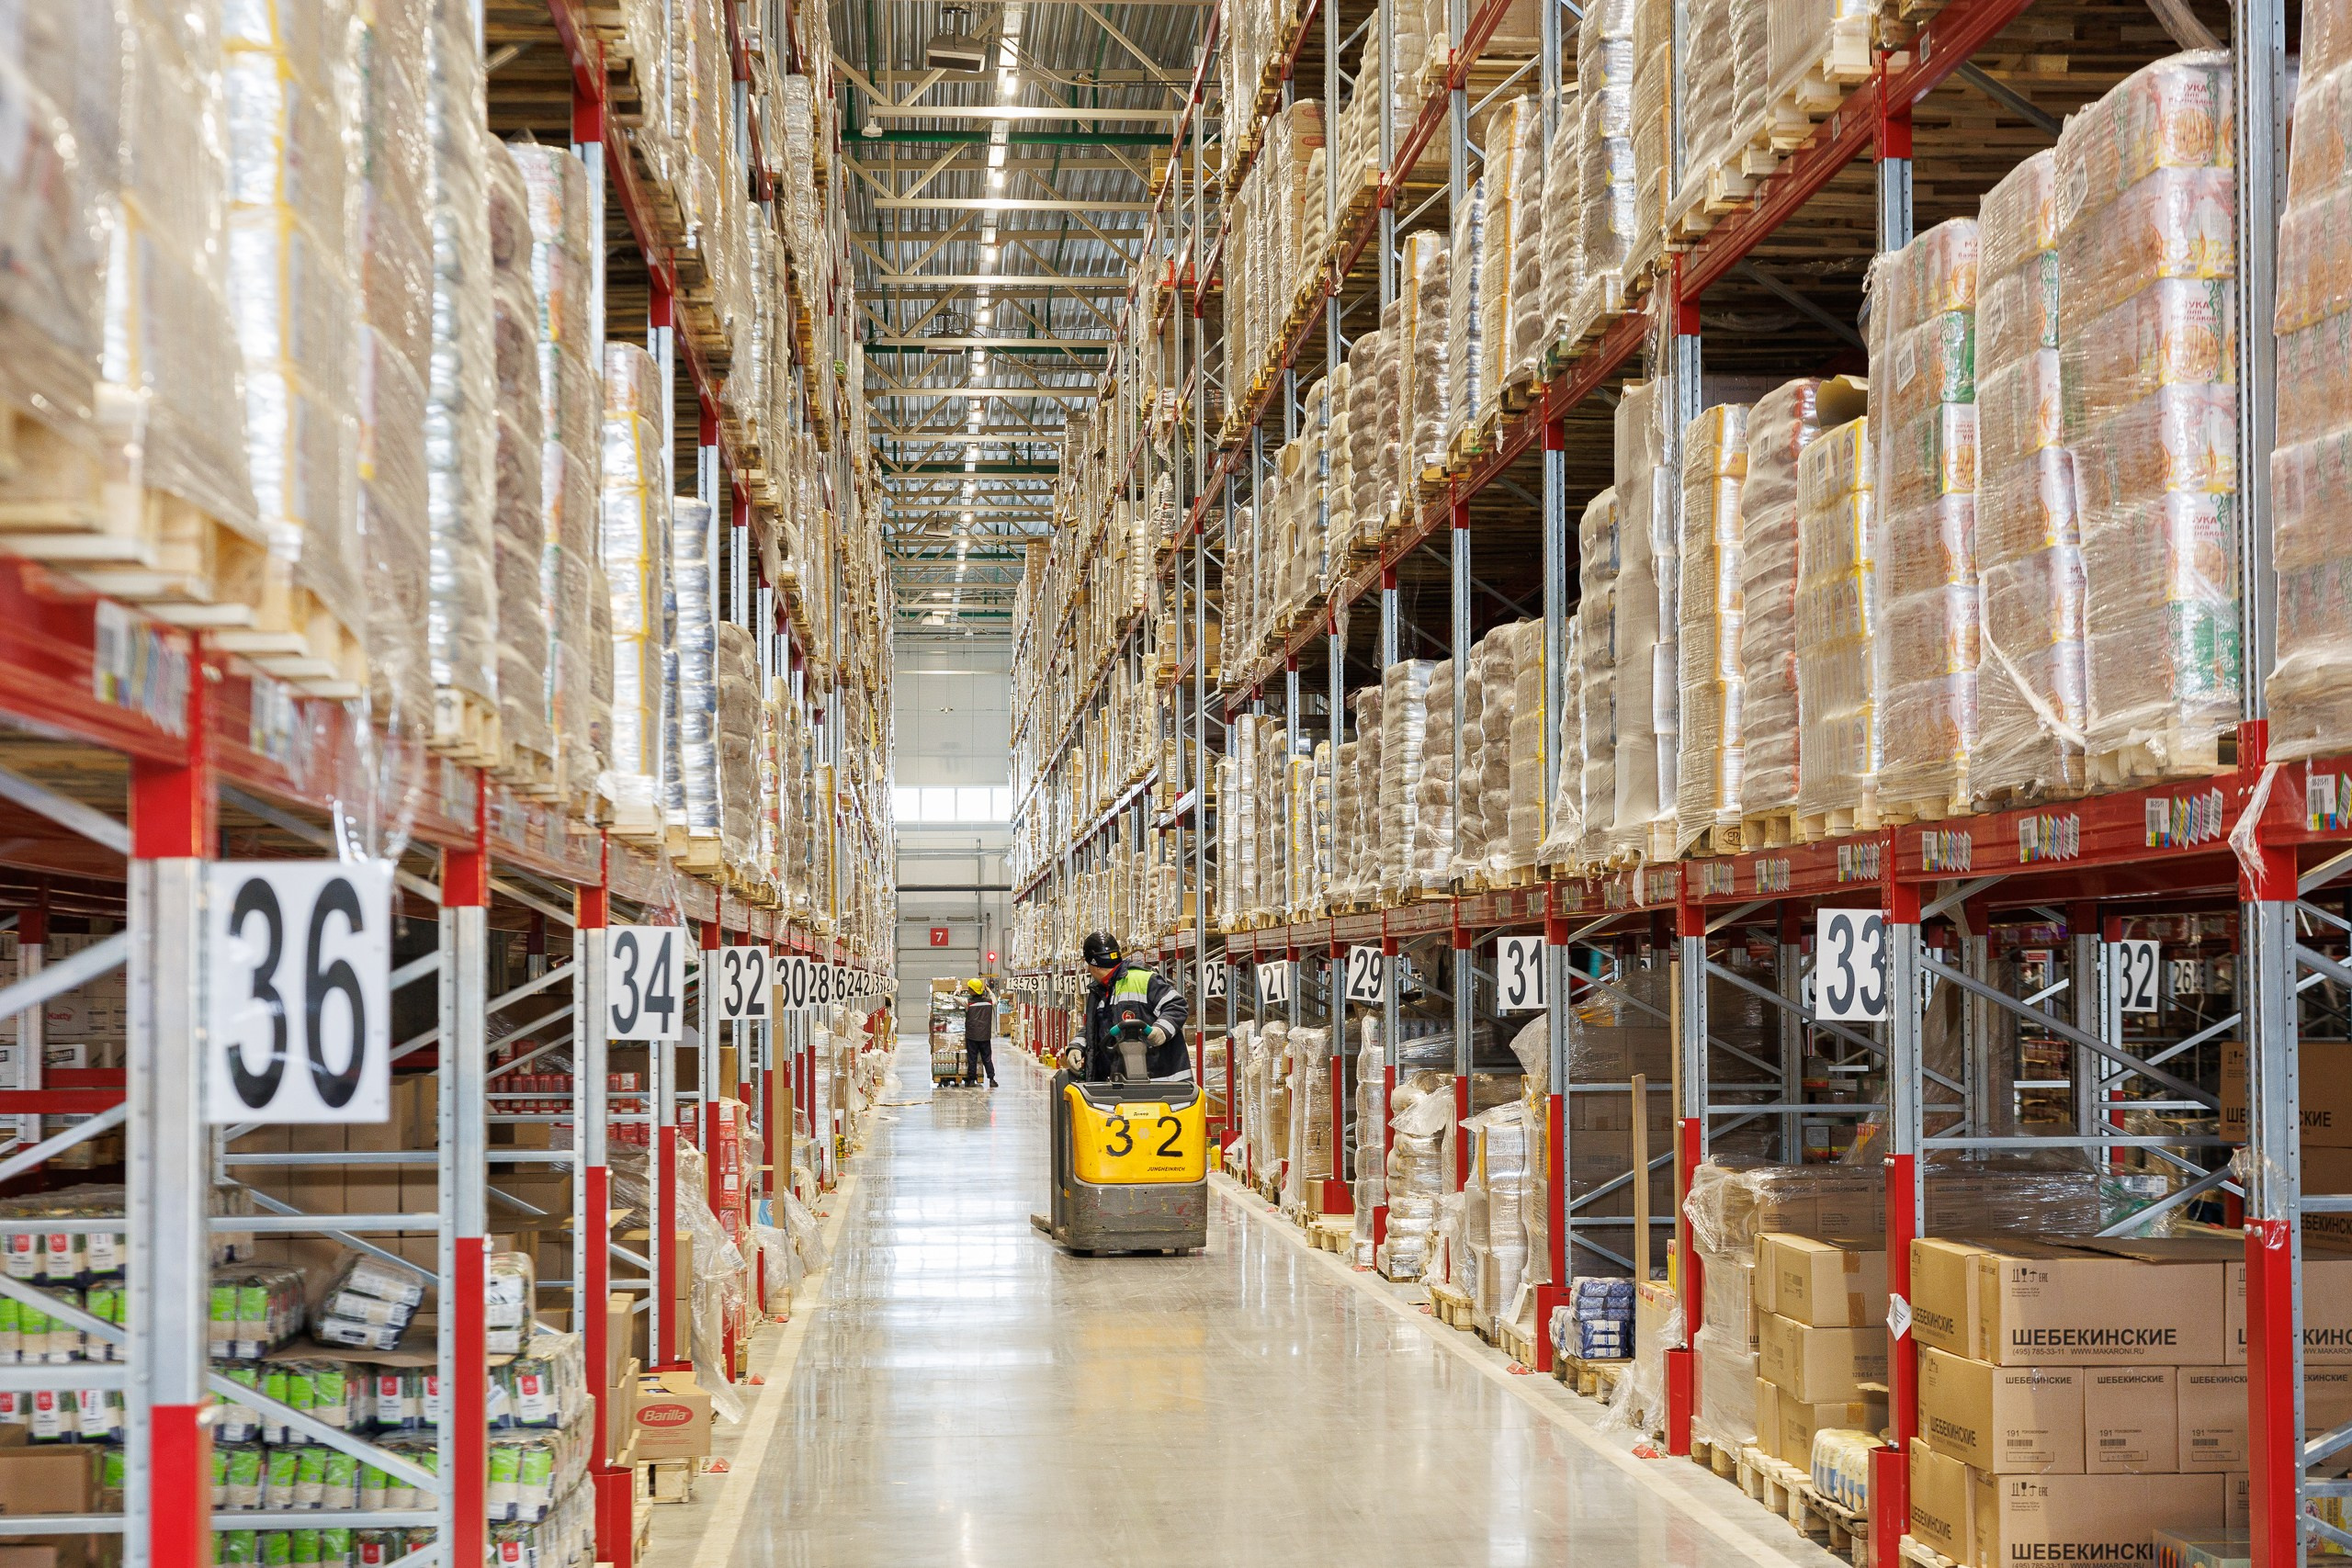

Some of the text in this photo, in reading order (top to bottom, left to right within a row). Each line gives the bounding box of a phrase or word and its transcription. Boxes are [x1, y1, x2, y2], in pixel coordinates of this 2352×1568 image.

[935, 931, 944, 942] 7
[1205, 962, 1227, 996] 25
[1351, 949, 1384, 999] 29
[1507, 940, 1544, 1006] 31
[1826, 914, 1886, 1016] 33
[2120, 942, 2154, 1009] 32
[228, 877, 368, 1110] 36
[611, 931, 675, 1034] 34
[724, 949, 764, 1017] 32
[776, 958, 807, 1009] 30
[809, 964, 830, 1004] 28
[832, 967, 845, 1000] 6
[847, 971, 863, 997] 24
[1031, 977, 1039, 990] 9
[1054, 975, 1065, 990] 13
[1066, 976, 1076, 993] 15
[1262, 963, 1284, 1002] 27
[1105, 1114, 1183, 1157] 3 2
[2301, 1213, 2352, 1235] ЕБЕКИНСК
[2012, 1328, 2177, 1346] ШЕБЕКИНСКИЕ
[2012, 1348, 2030, 1356] (495)
[2070, 1347, 2145, 1356] WWW.MAKARONI.RU
[2006, 1376, 2073, 1384] ШЕБЕКИНСКИЕ
[2098, 1375, 2165, 1384] ШЕБЕКИНСКИЕ
[2190, 1375, 2248, 1384] ШЕБЕКИНСК
[2303, 1374, 2348, 1382] ЕКИНСКИЕ
[643, 1409, 688, 1422] Barilla
[1930, 1415, 1977, 1448] ШЕБЕКИНСКИЕ
[2012, 1543, 2154, 1561] ШЕБЕКИНСК
